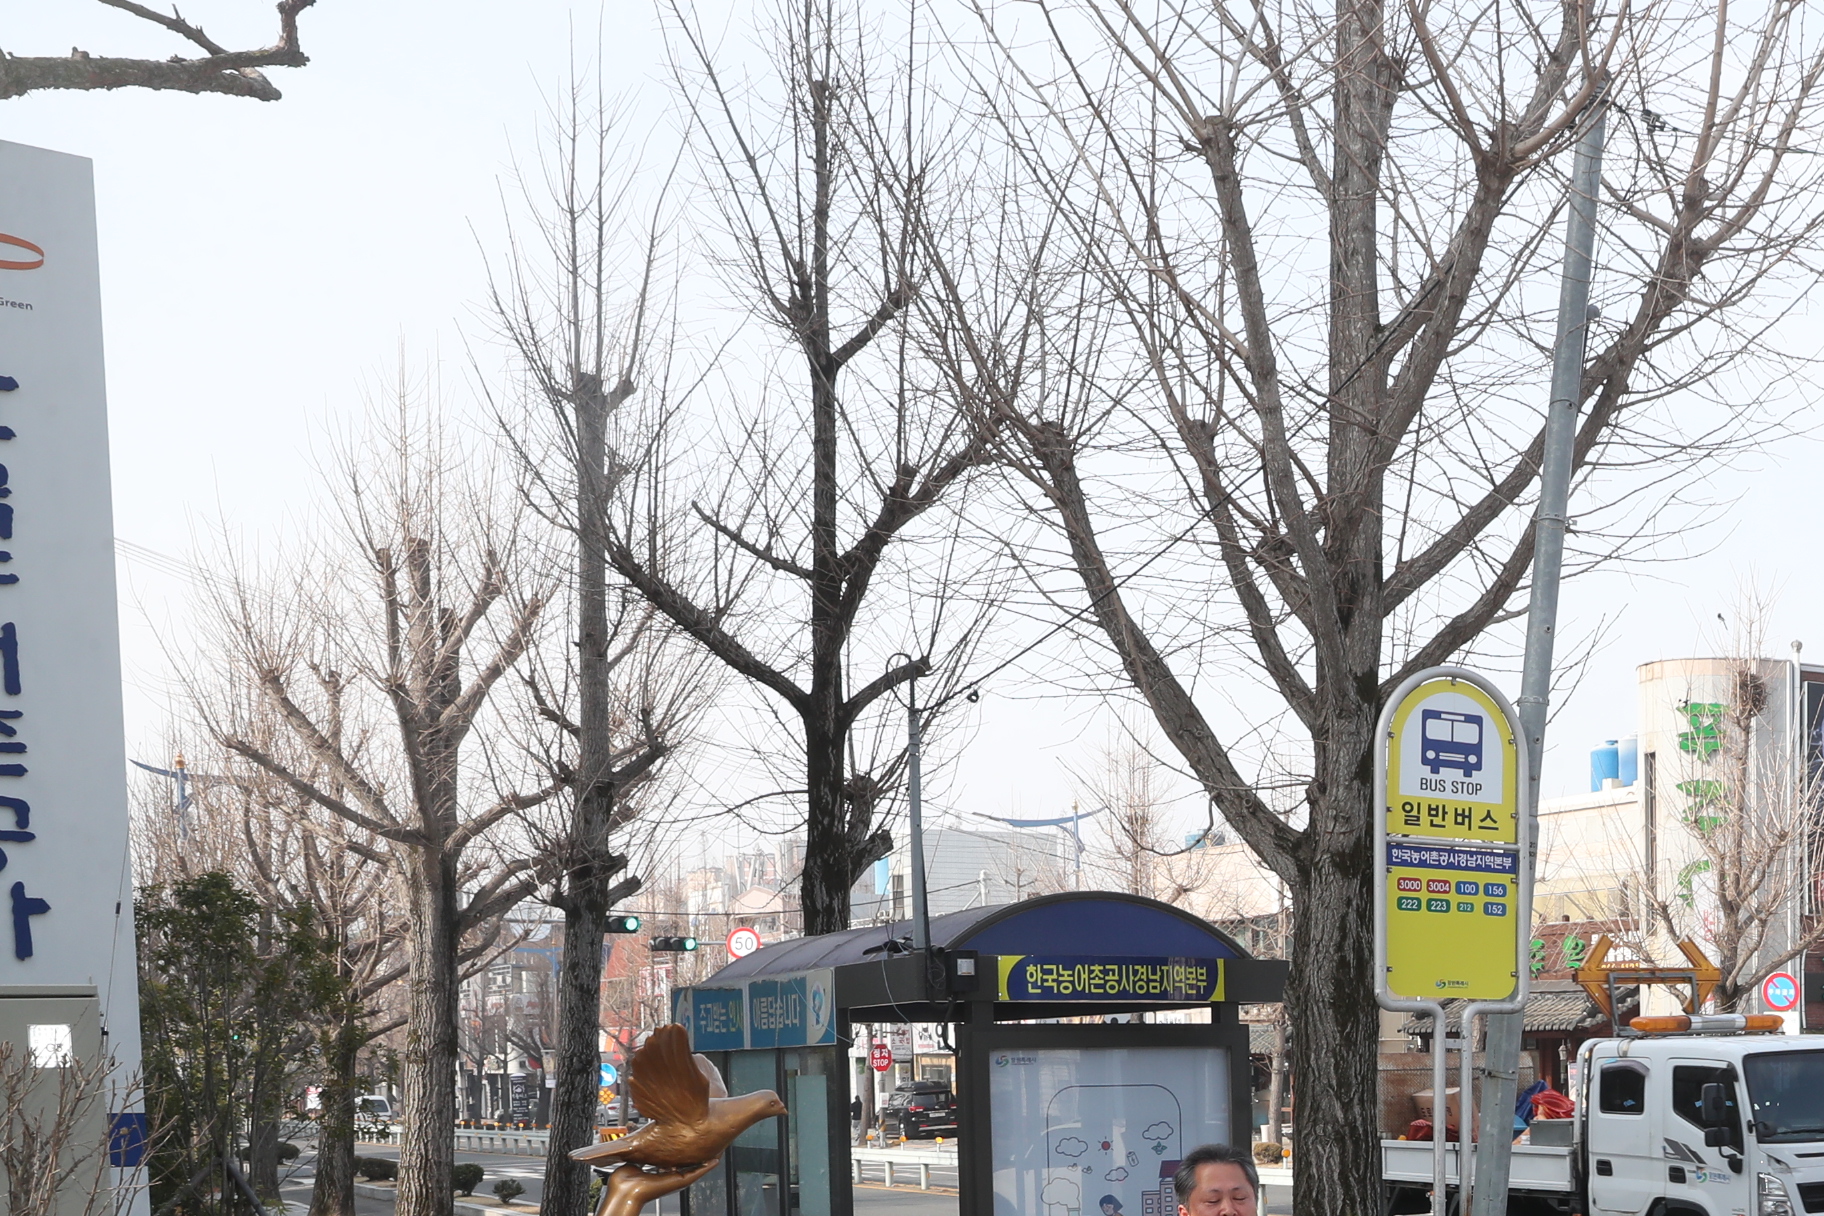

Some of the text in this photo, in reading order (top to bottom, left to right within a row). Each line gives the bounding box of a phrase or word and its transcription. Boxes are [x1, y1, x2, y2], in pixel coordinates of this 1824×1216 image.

[1420, 777, 1482, 796] BUS STOP
[1401, 801, 1500, 832] 일반버스
[1391, 848, 1512, 870] 한국농어촌공사경남지역본부
[1399, 880, 1504, 896] 3000 3004 100 156
[1401, 899, 1418, 909] 222
[1431, 901, 1447, 911] 223
[1487, 904, 1503, 914] 152
[735, 937, 754, 951] 50
[1026, 964, 1207, 995] 한국농어촌공사경남지역본부
[699, 1002, 727, 1034] 주고받는
[873, 1058, 889, 1067] STOP
